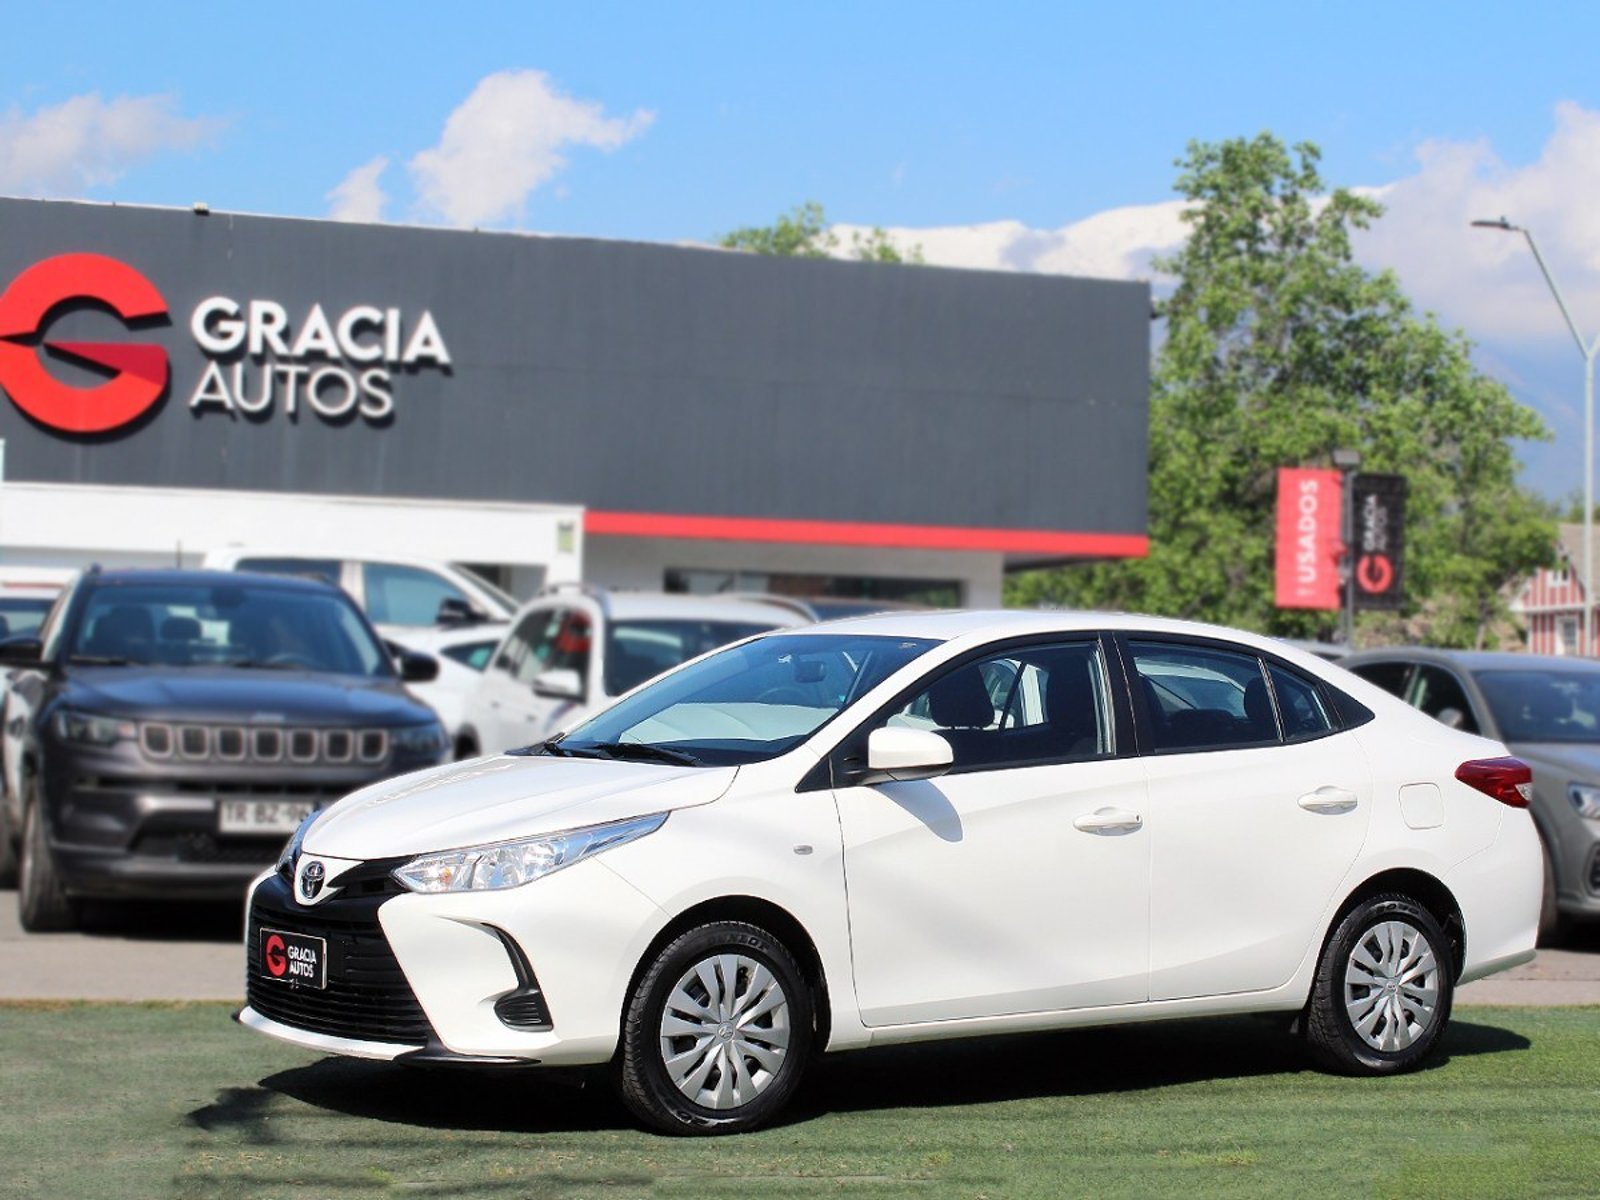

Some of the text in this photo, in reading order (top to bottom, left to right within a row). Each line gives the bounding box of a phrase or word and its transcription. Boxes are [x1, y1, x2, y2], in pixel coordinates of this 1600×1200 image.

[191, 296, 451, 364] GRACIA
[188, 360, 393, 417] AUTOS
[1296, 480, 1318, 583] USADOS
[287, 945, 317, 964] GRACIA
[289, 961, 314, 978] AUTOS
